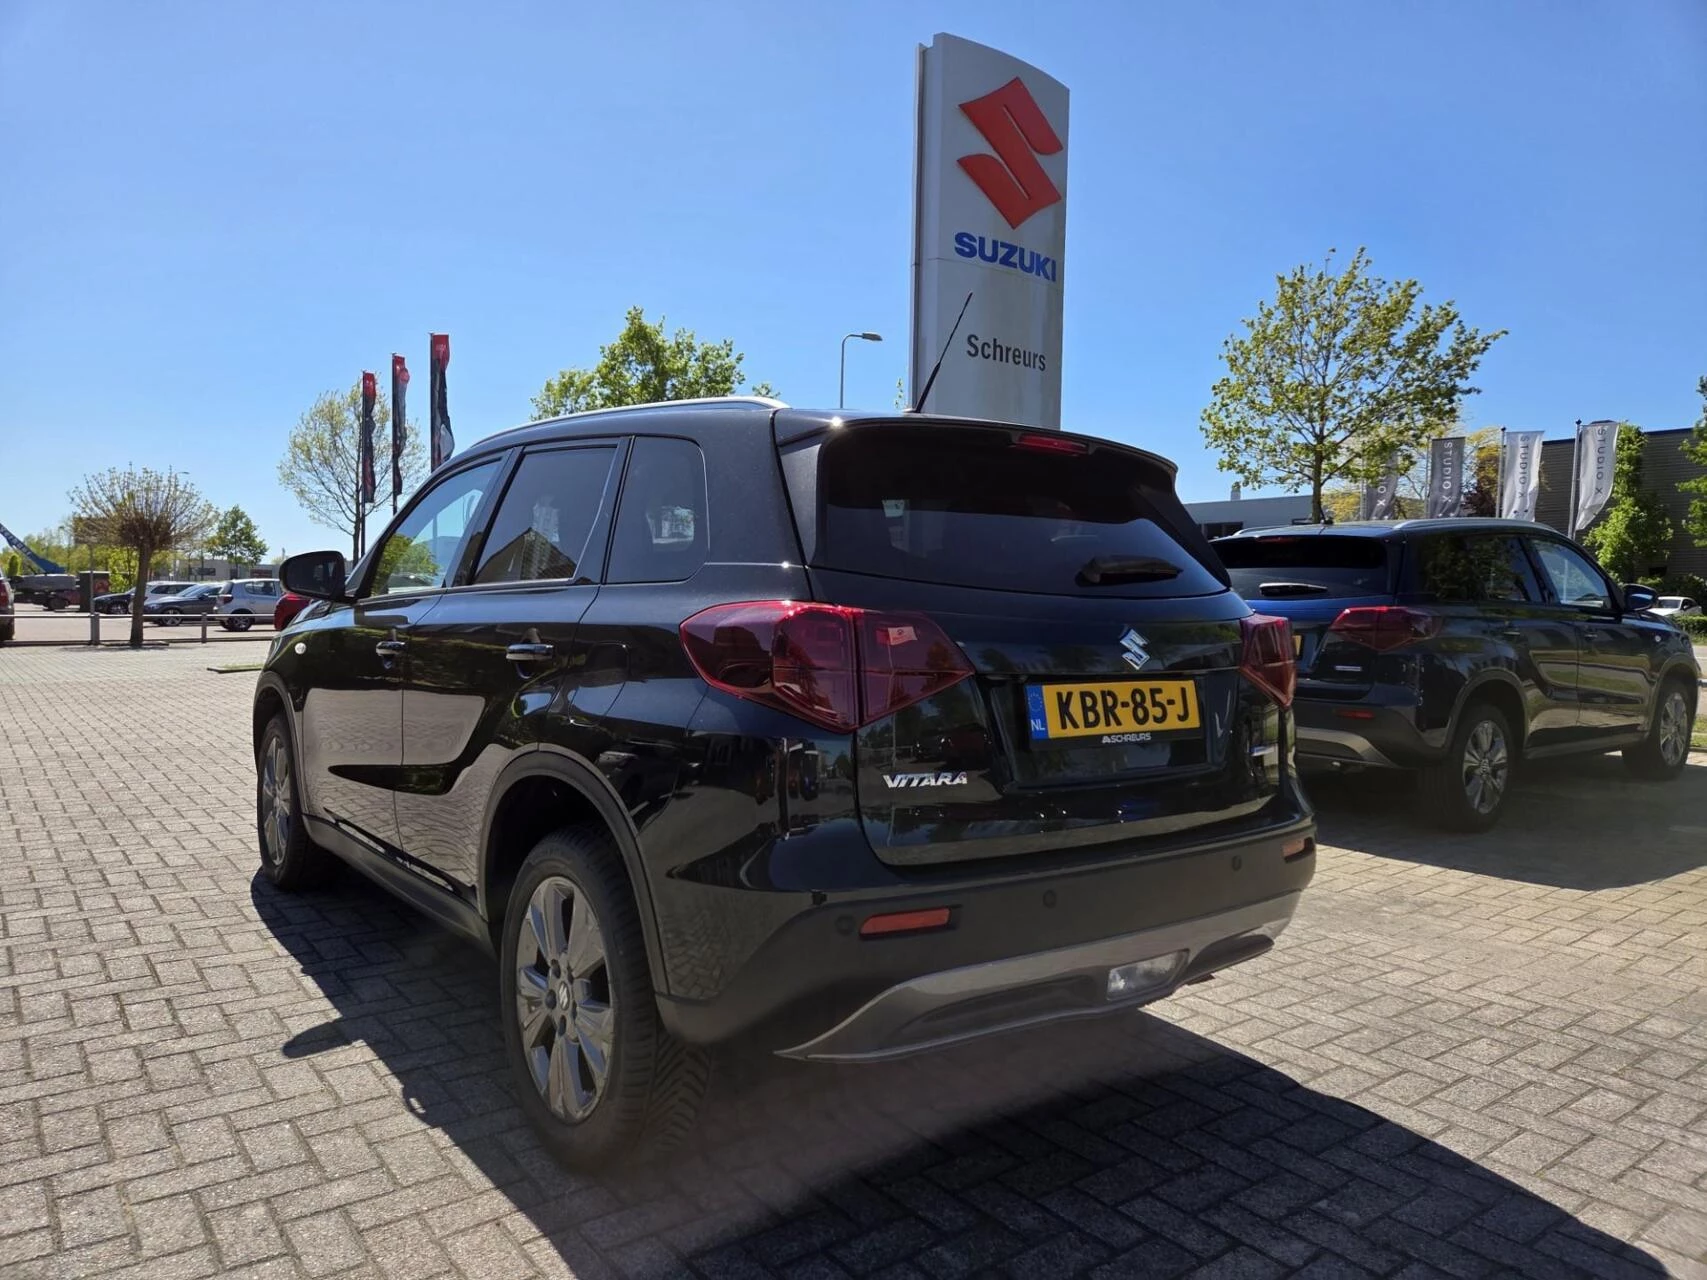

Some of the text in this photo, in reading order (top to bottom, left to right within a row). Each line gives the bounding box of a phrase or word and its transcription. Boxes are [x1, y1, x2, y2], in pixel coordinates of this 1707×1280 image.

[954, 232, 1056, 282] SUZUKI
[966, 334, 1046, 371] Schreurs
[1442, 441, 1453, 503] STUDIO X
[1518, 435, 1530, 485] STUDIO
[1594, 428, 1607, 496] STUDIO X
[1030, 719, 1046, 732] NL
[1056, 687, 1190, 730] KBR-85-J
[883, 771, 968, 789] VITARA
